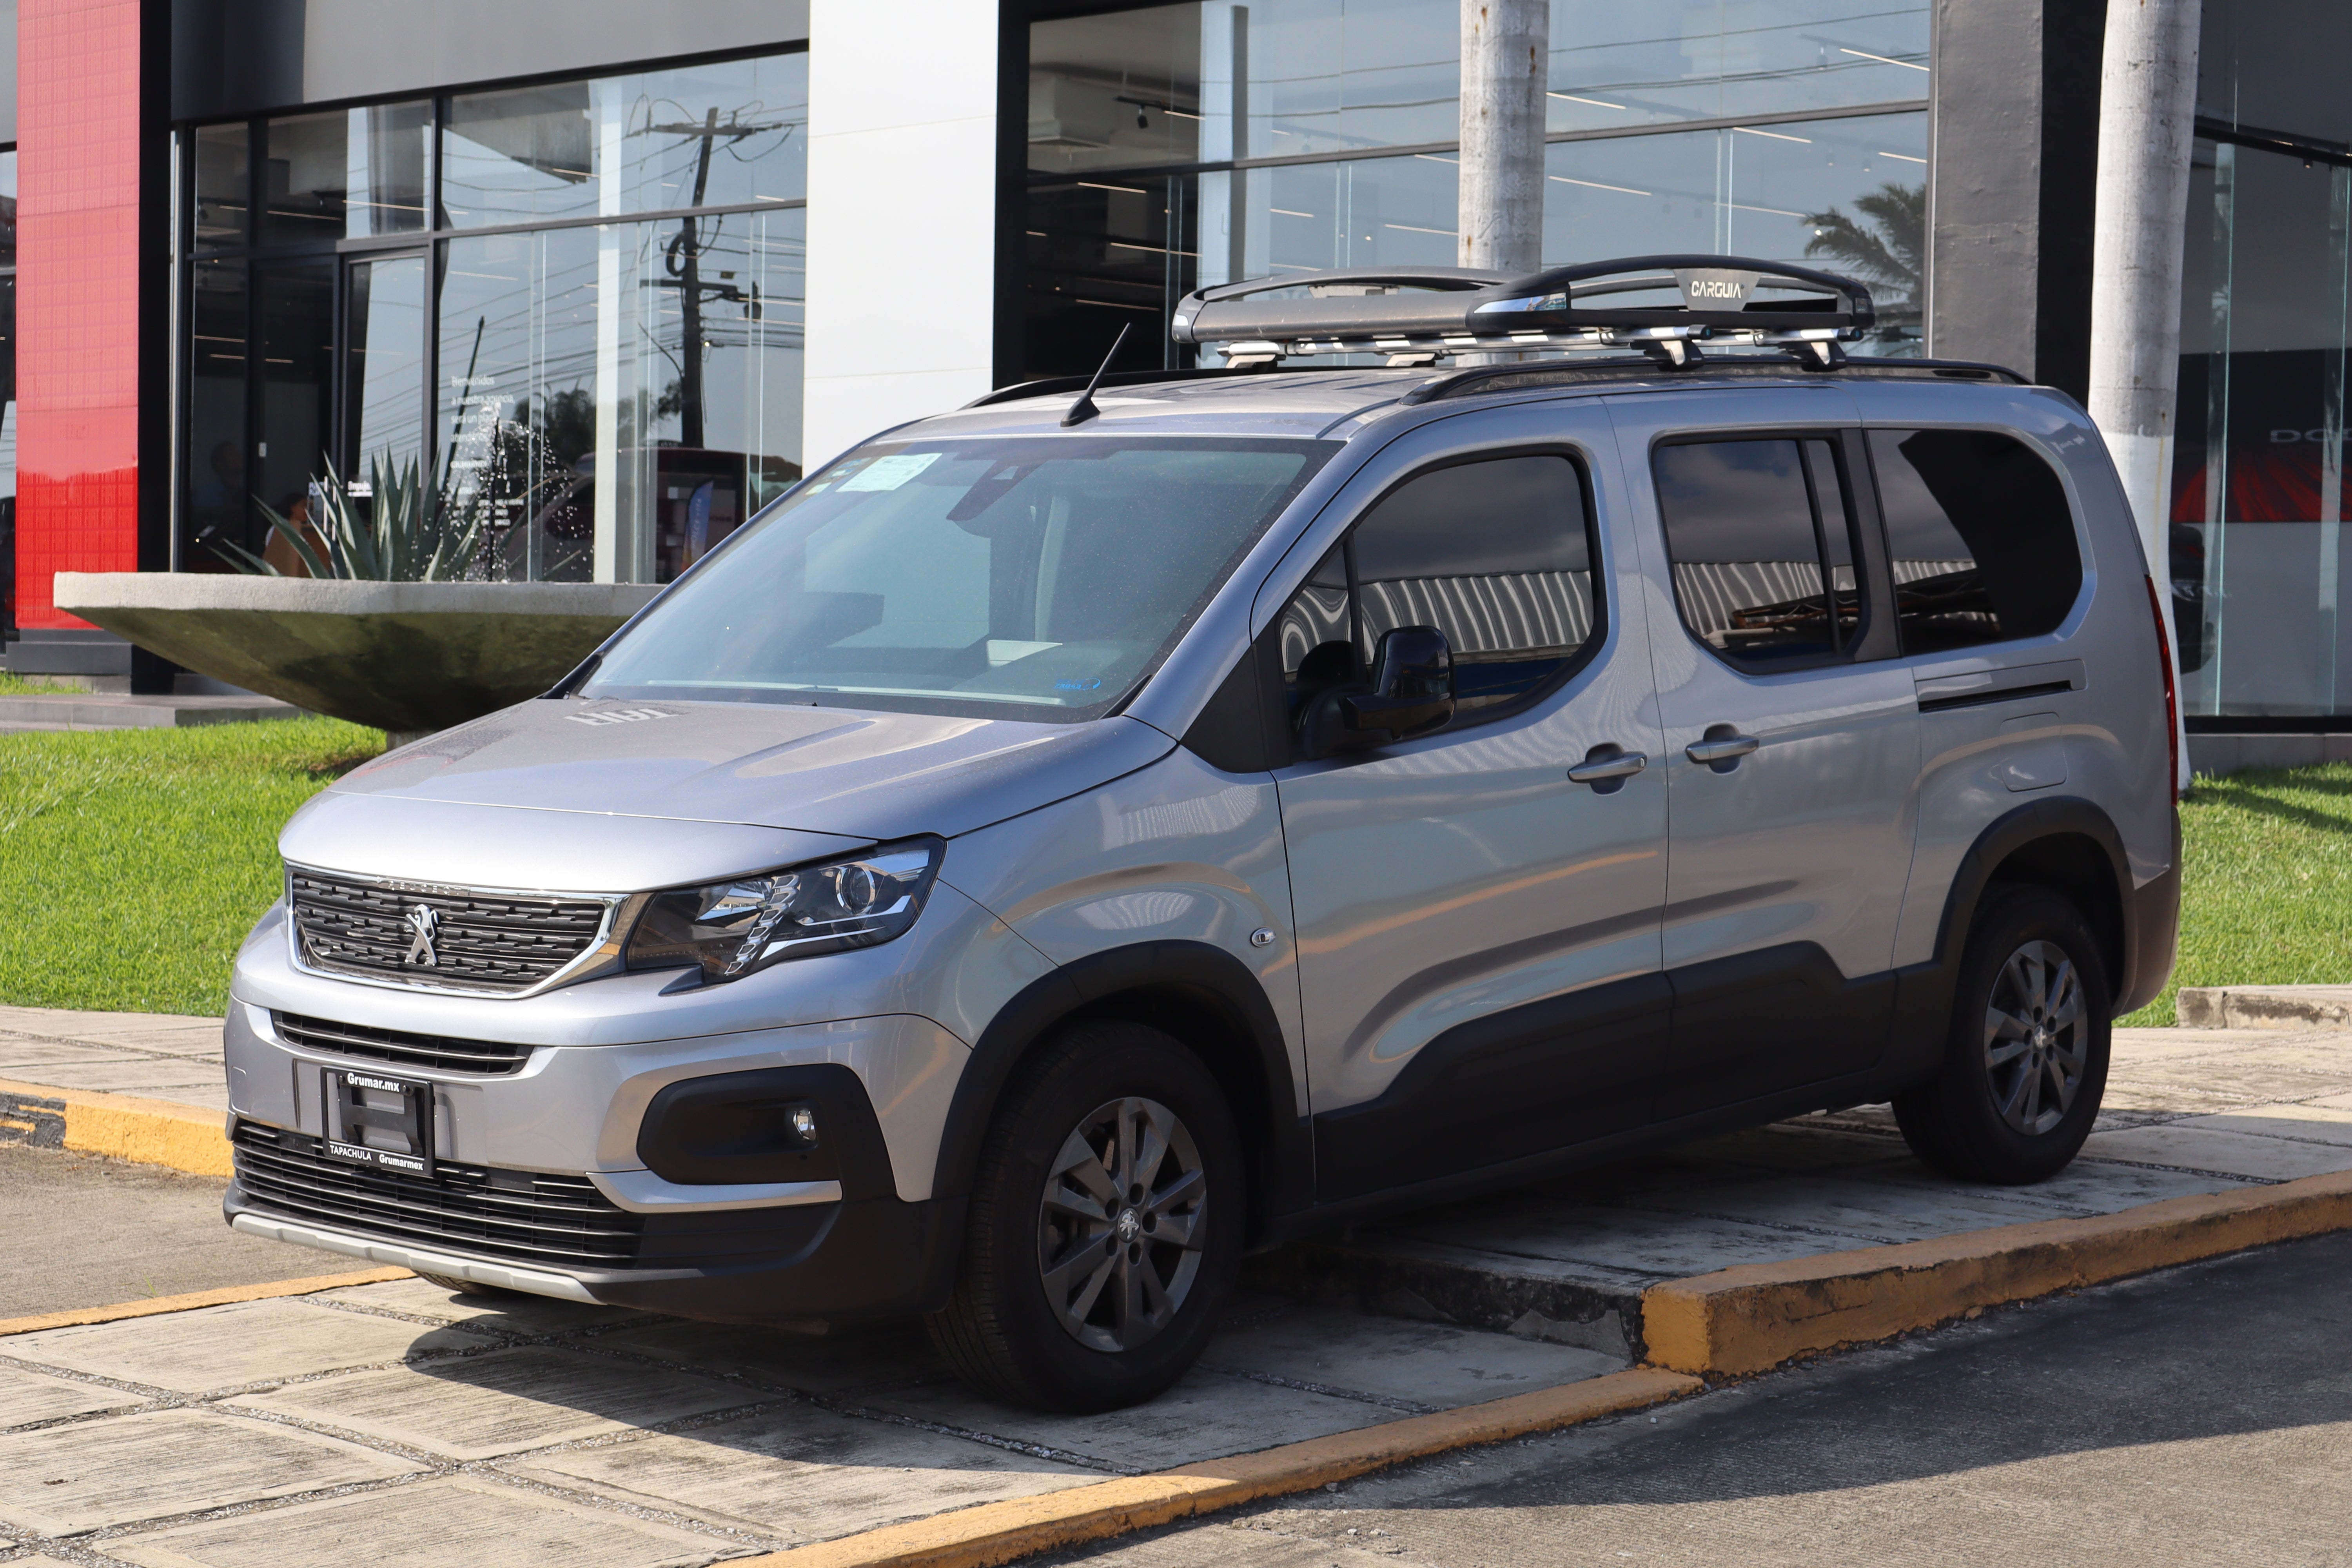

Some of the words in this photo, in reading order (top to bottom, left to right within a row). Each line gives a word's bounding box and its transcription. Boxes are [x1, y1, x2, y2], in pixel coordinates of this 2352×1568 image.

[1691, 280, 1741, 298] CARGUIA
[387, 880, 461, 896] PEUGEOT
[347, 1073, 399, 1092] Grumar.mx
[330, 1145, 372, 1161] TAPACHULA
[379, 1154, 423, 1171] Grumarmex
